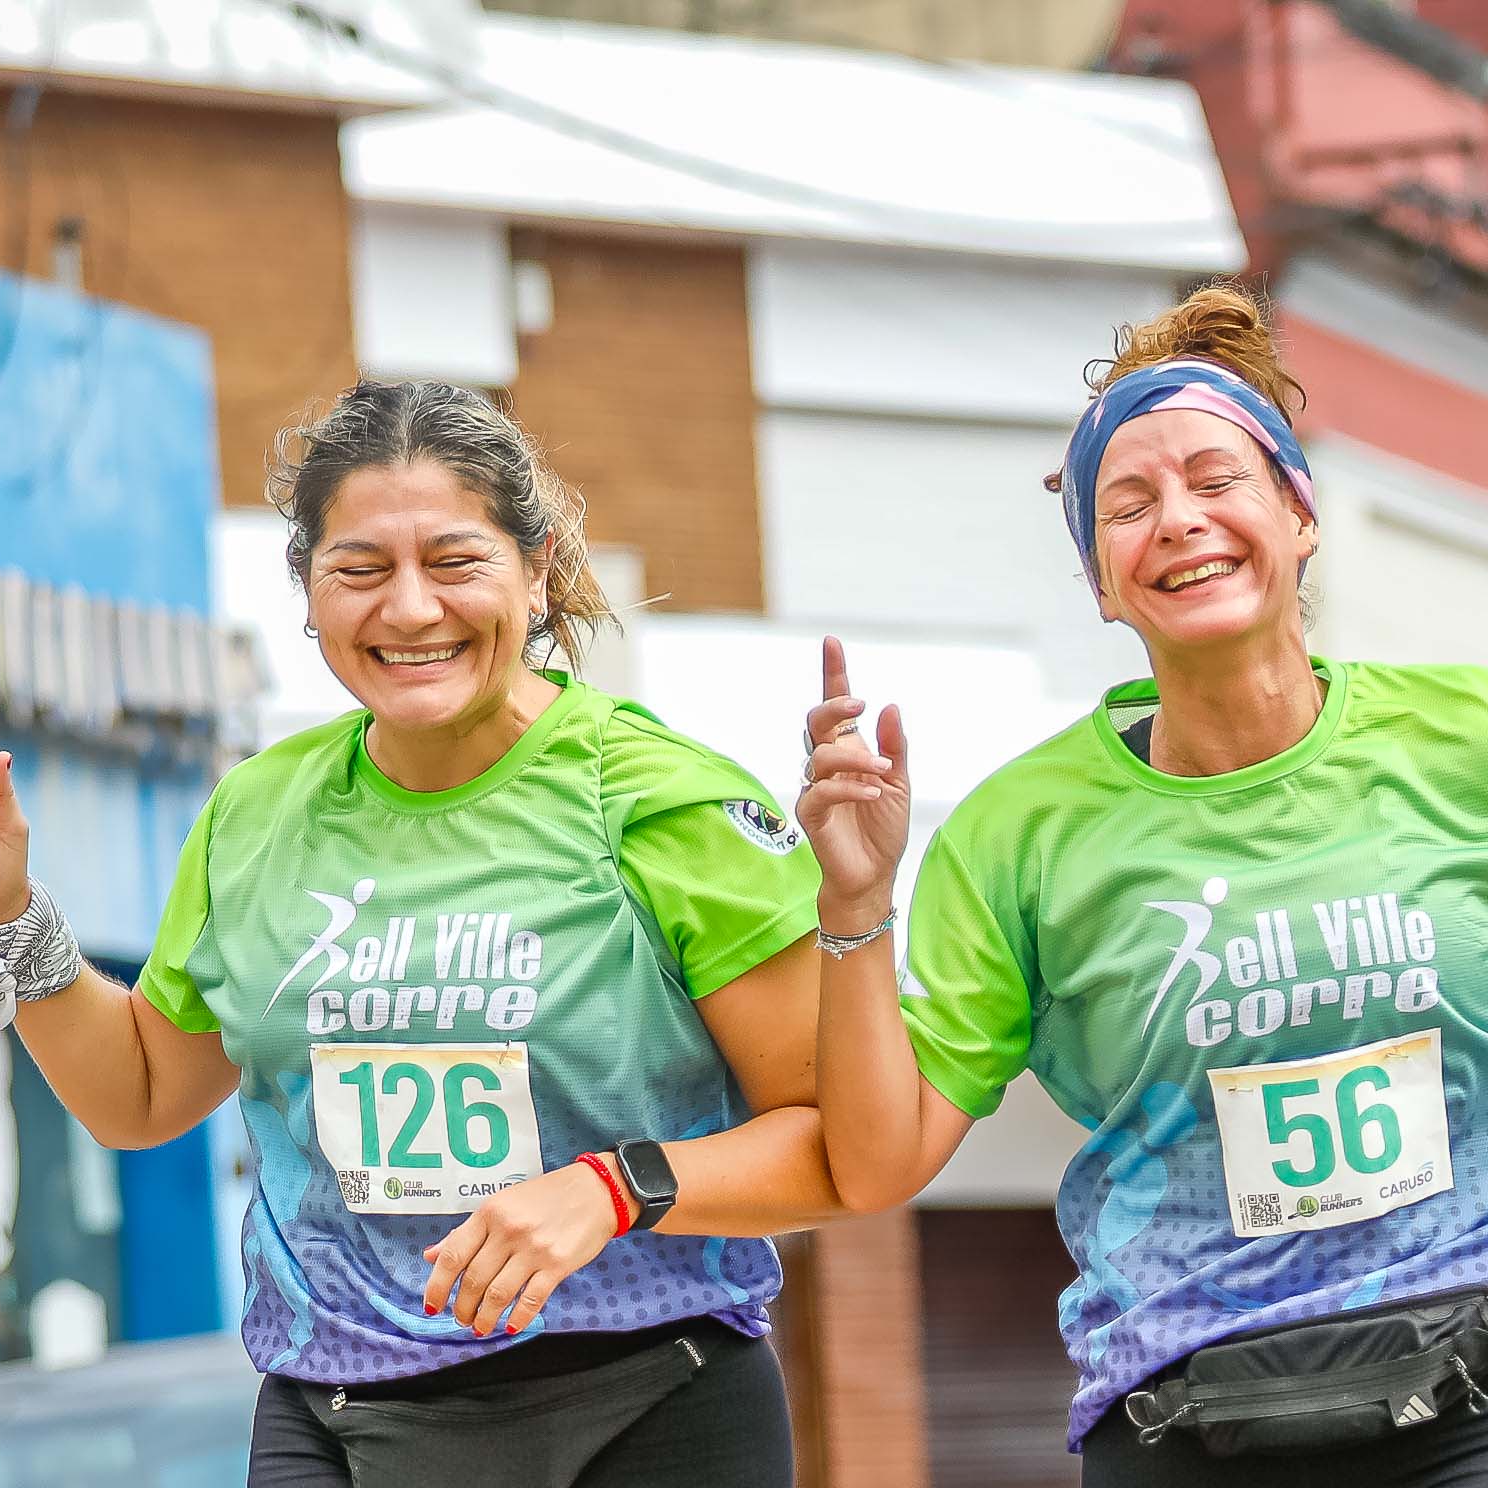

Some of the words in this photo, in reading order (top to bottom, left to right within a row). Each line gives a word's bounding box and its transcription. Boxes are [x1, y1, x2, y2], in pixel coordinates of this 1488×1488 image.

[435, 912, 543, 981] Ville
[1312, 893, 1436, 970] Ville
[306, 984, 539, 1035] corre
[1185, 967, 1440, 1047] corre
[339, 1062, 510, 1168] 126
[1262, 1065, 1402, 1187] 56
[458, 1181, 523, 1197] CARU
[1379, 1170, 1433, 1199] CARUSO
